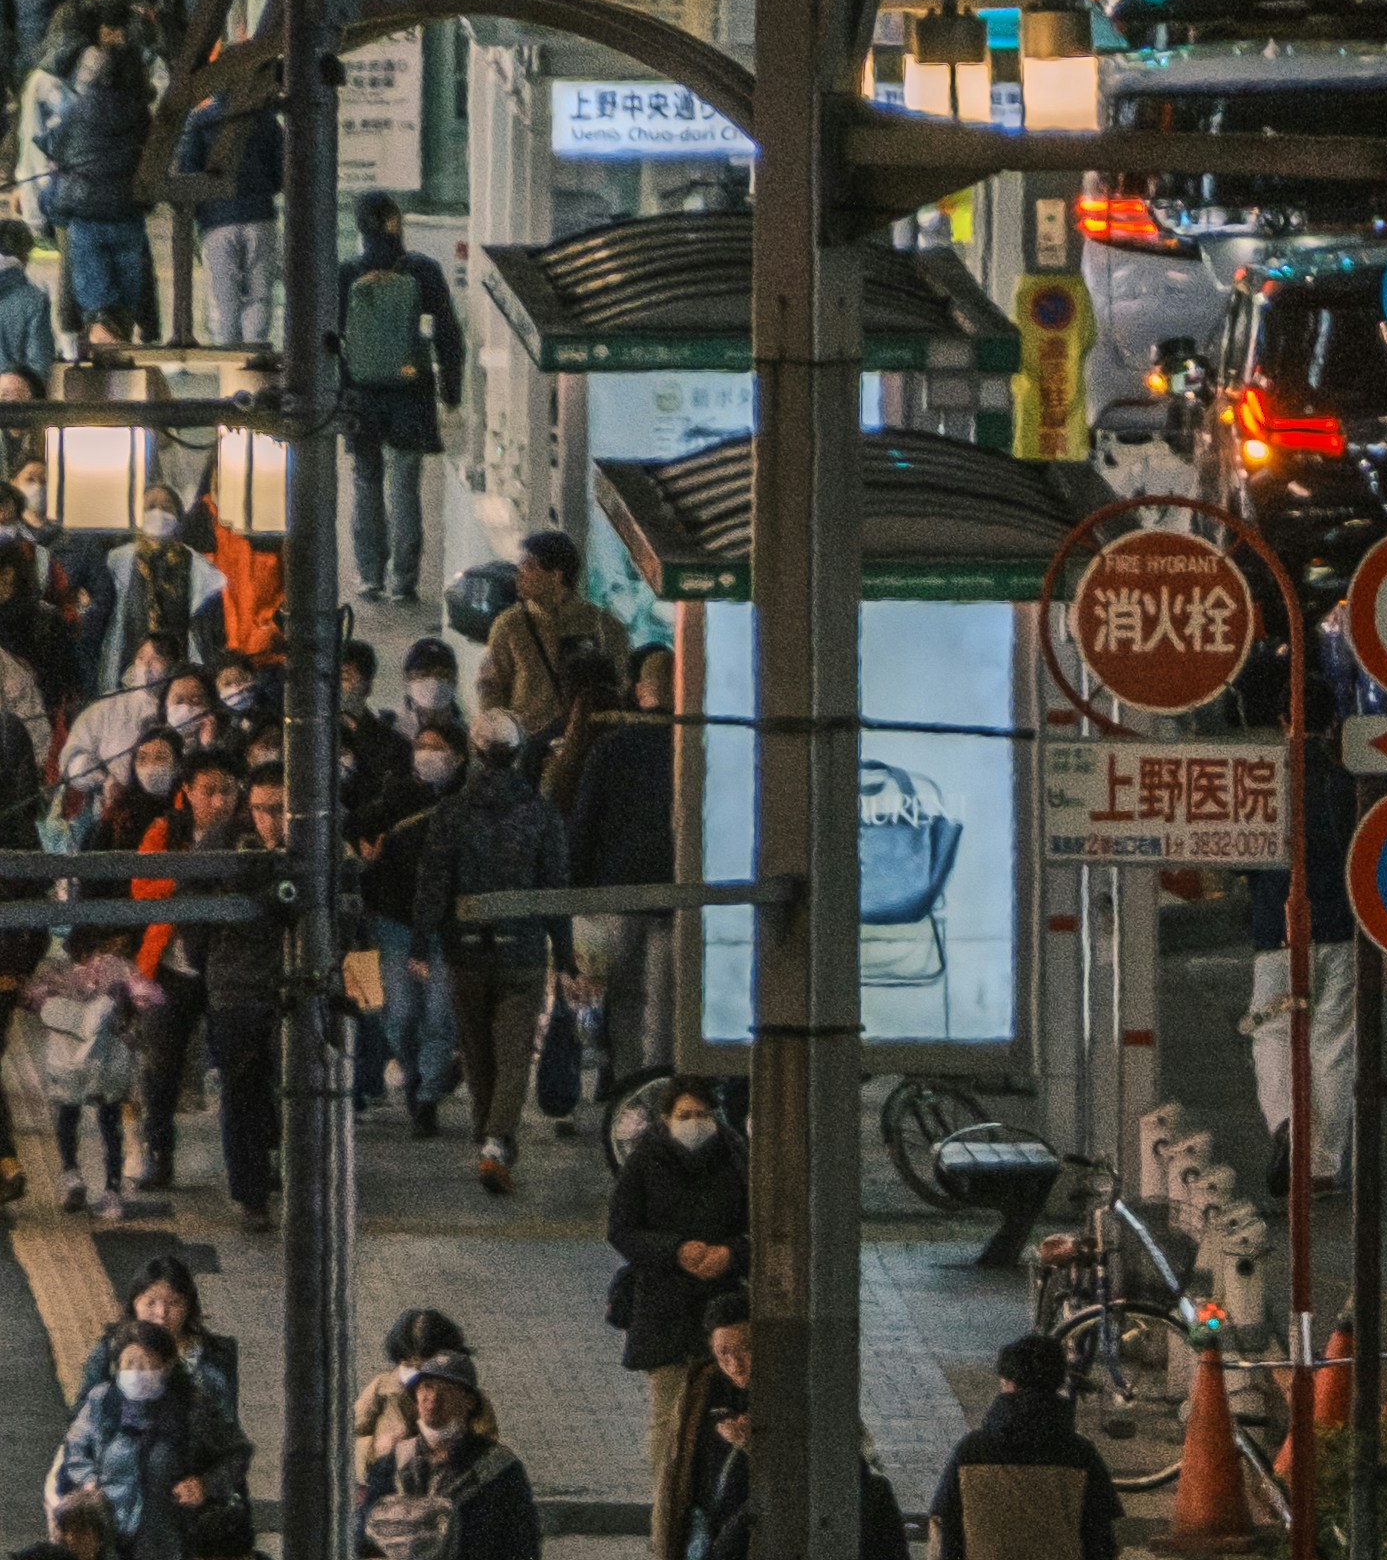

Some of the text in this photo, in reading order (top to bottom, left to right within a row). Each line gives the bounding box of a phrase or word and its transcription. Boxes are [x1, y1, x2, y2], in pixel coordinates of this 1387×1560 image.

[571, 125, 622, 142] Ueno
[1103, 554, 1219, 575] FIRE HYDRANT
[1093, 584, 1238, 654] 消火栓
[1088, 753, 1278, 824] 上野医院
